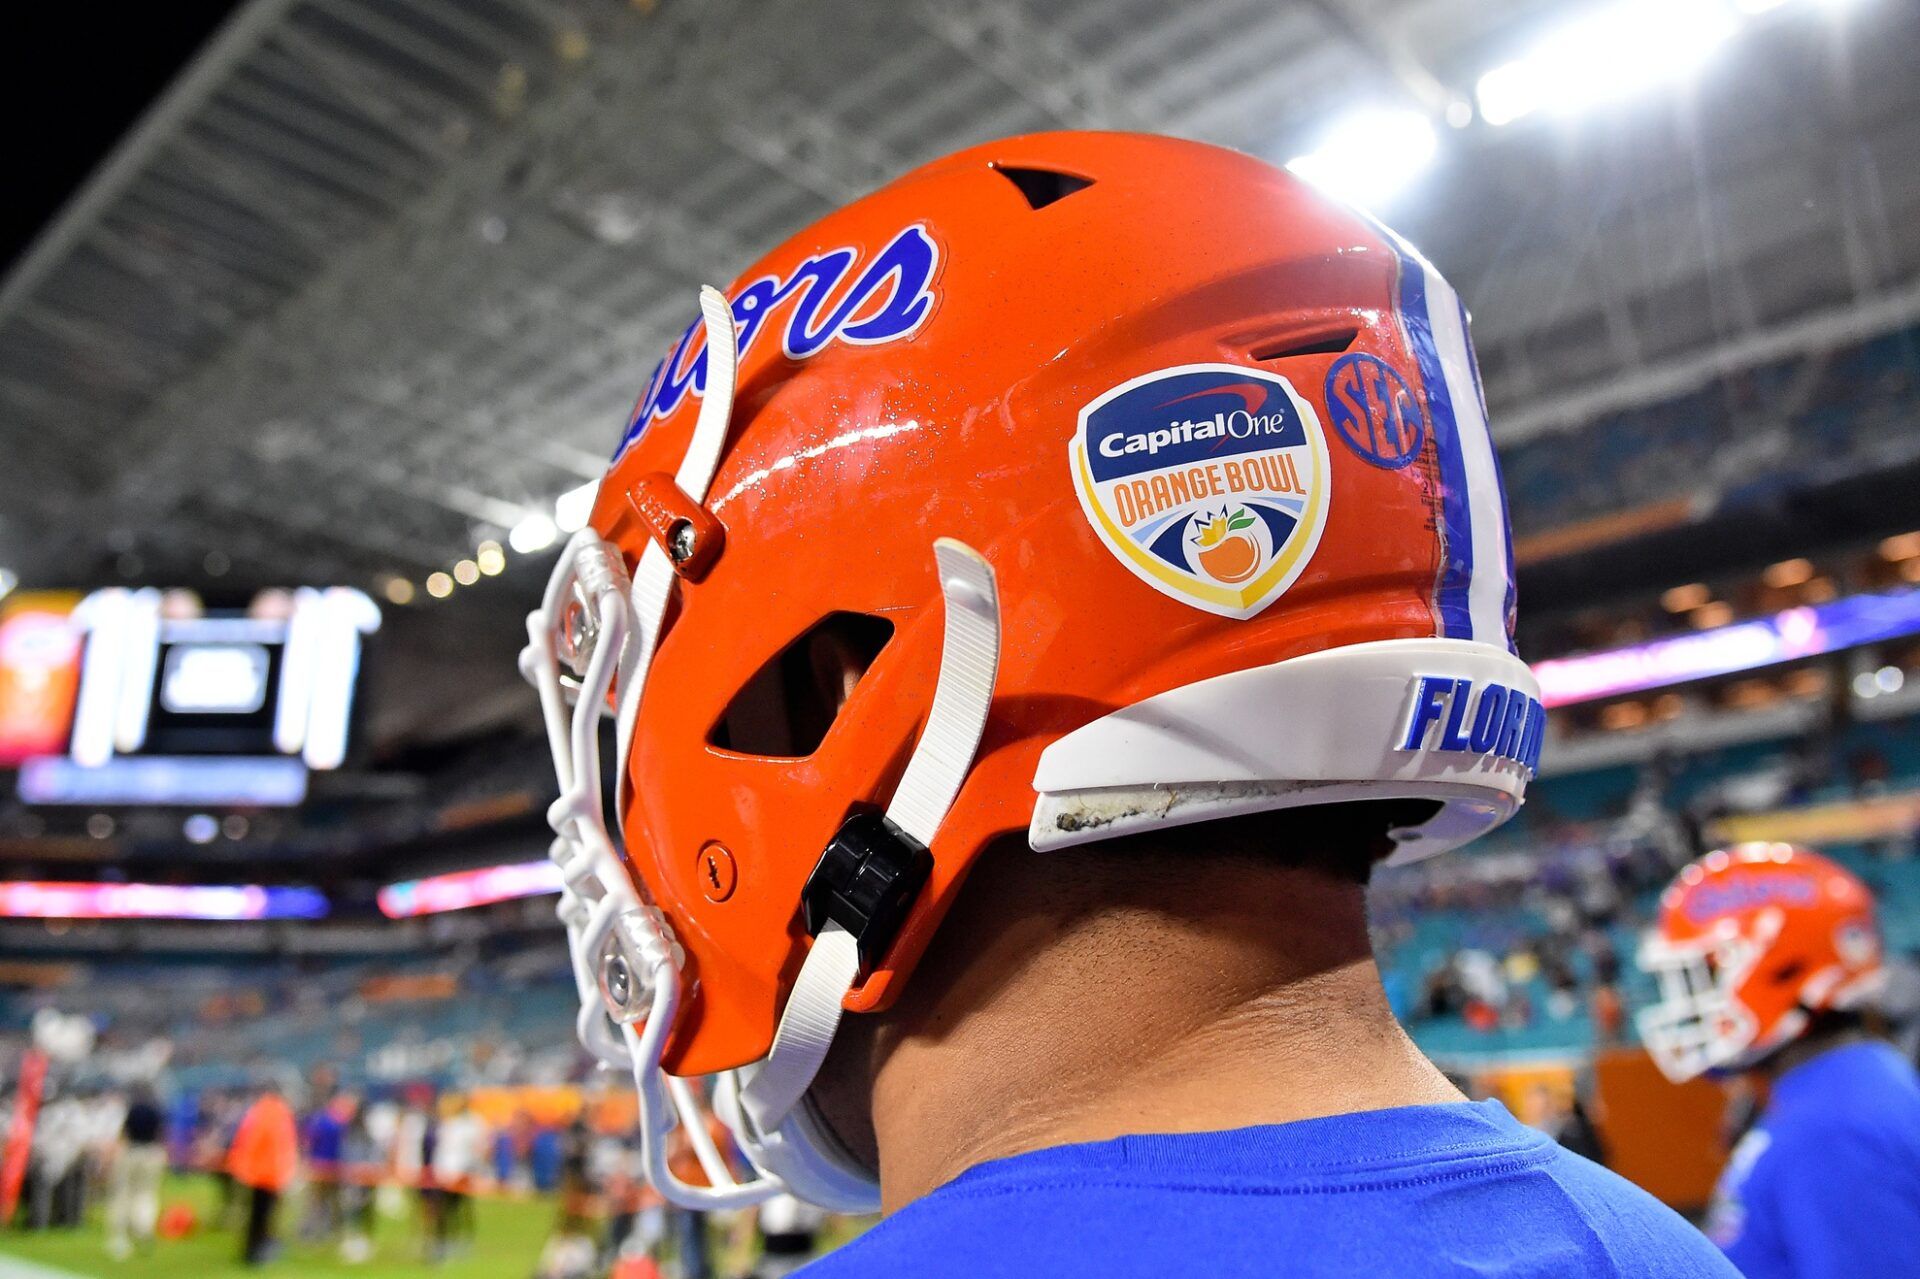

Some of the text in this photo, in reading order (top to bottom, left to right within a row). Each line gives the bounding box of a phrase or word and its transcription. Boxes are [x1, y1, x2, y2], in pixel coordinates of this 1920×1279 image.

[1332, 359, 1419, 460] SEC
[1113, 453, 1307, 528] ORANGE BOWL
